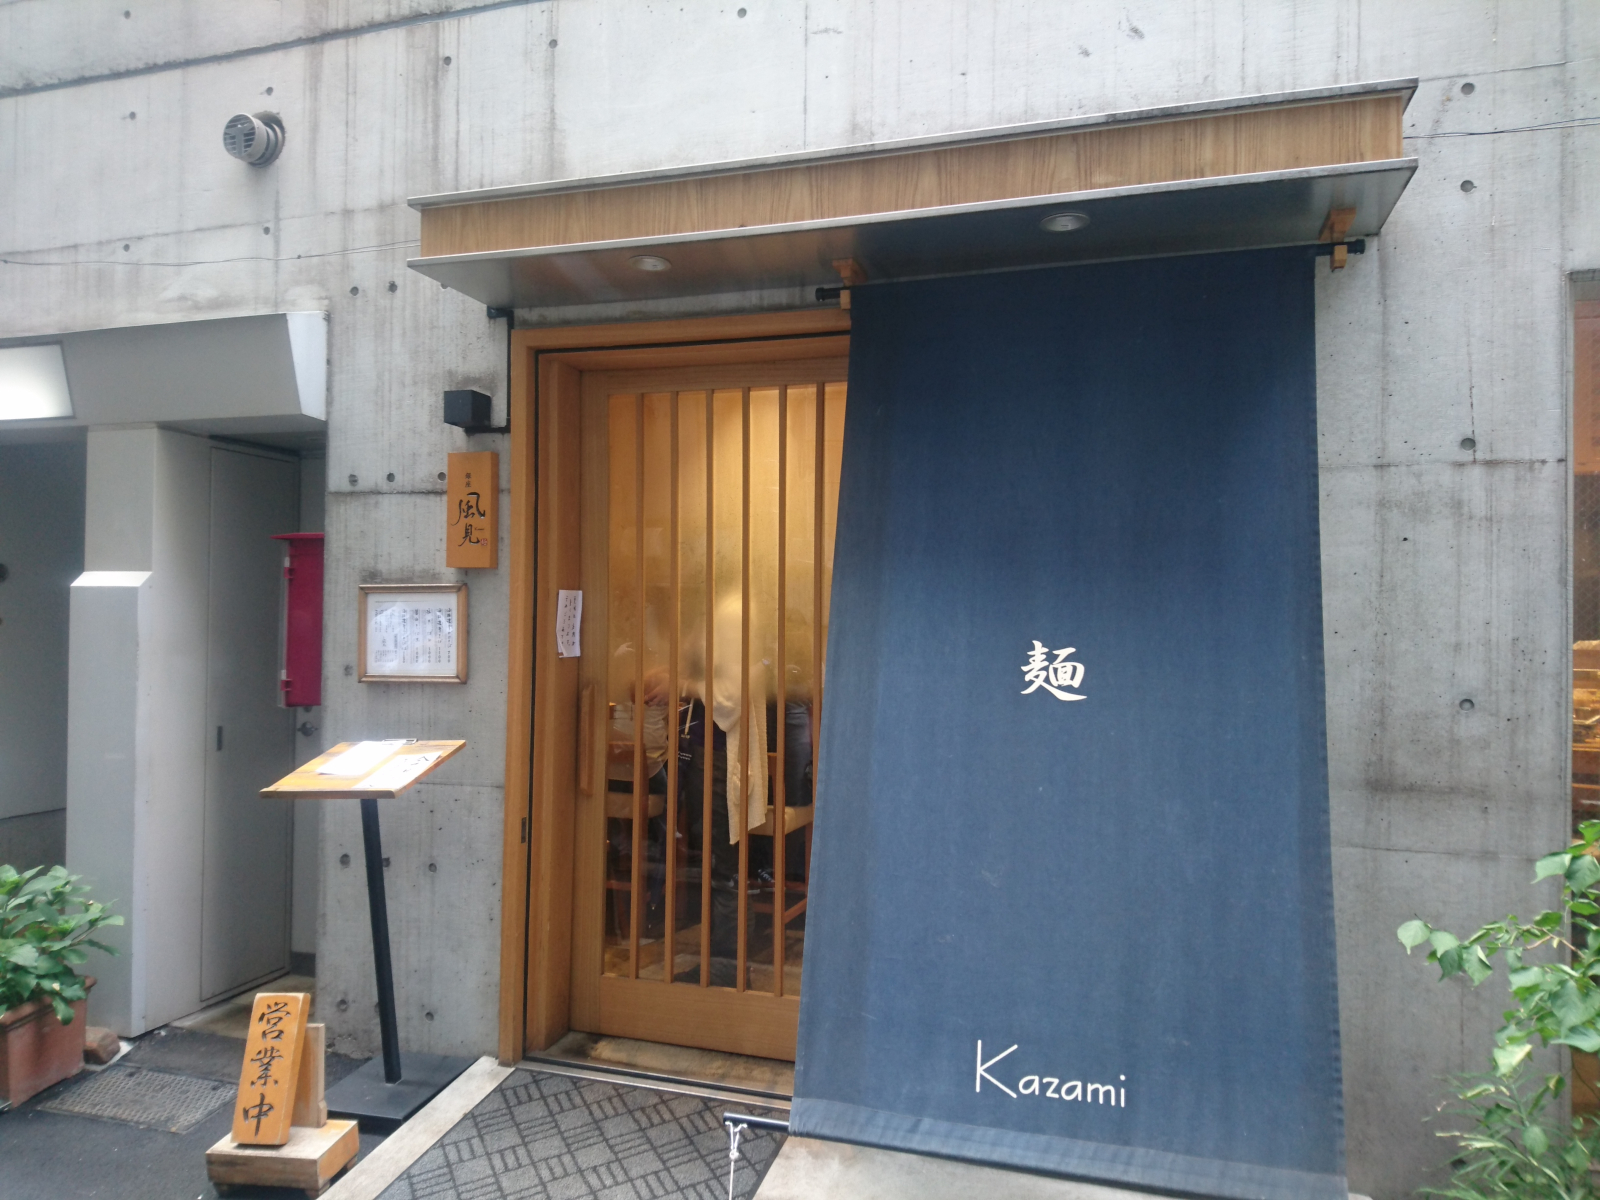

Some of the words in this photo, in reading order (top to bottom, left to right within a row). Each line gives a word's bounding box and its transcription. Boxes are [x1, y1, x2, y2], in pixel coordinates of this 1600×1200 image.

[451, 491, 486, 547] 風見
[1020, 640, 1088, 702] 麺
[243, 1001, 291, 1137] 営業中
[975, 1039, 1127, 1108] Kazami
